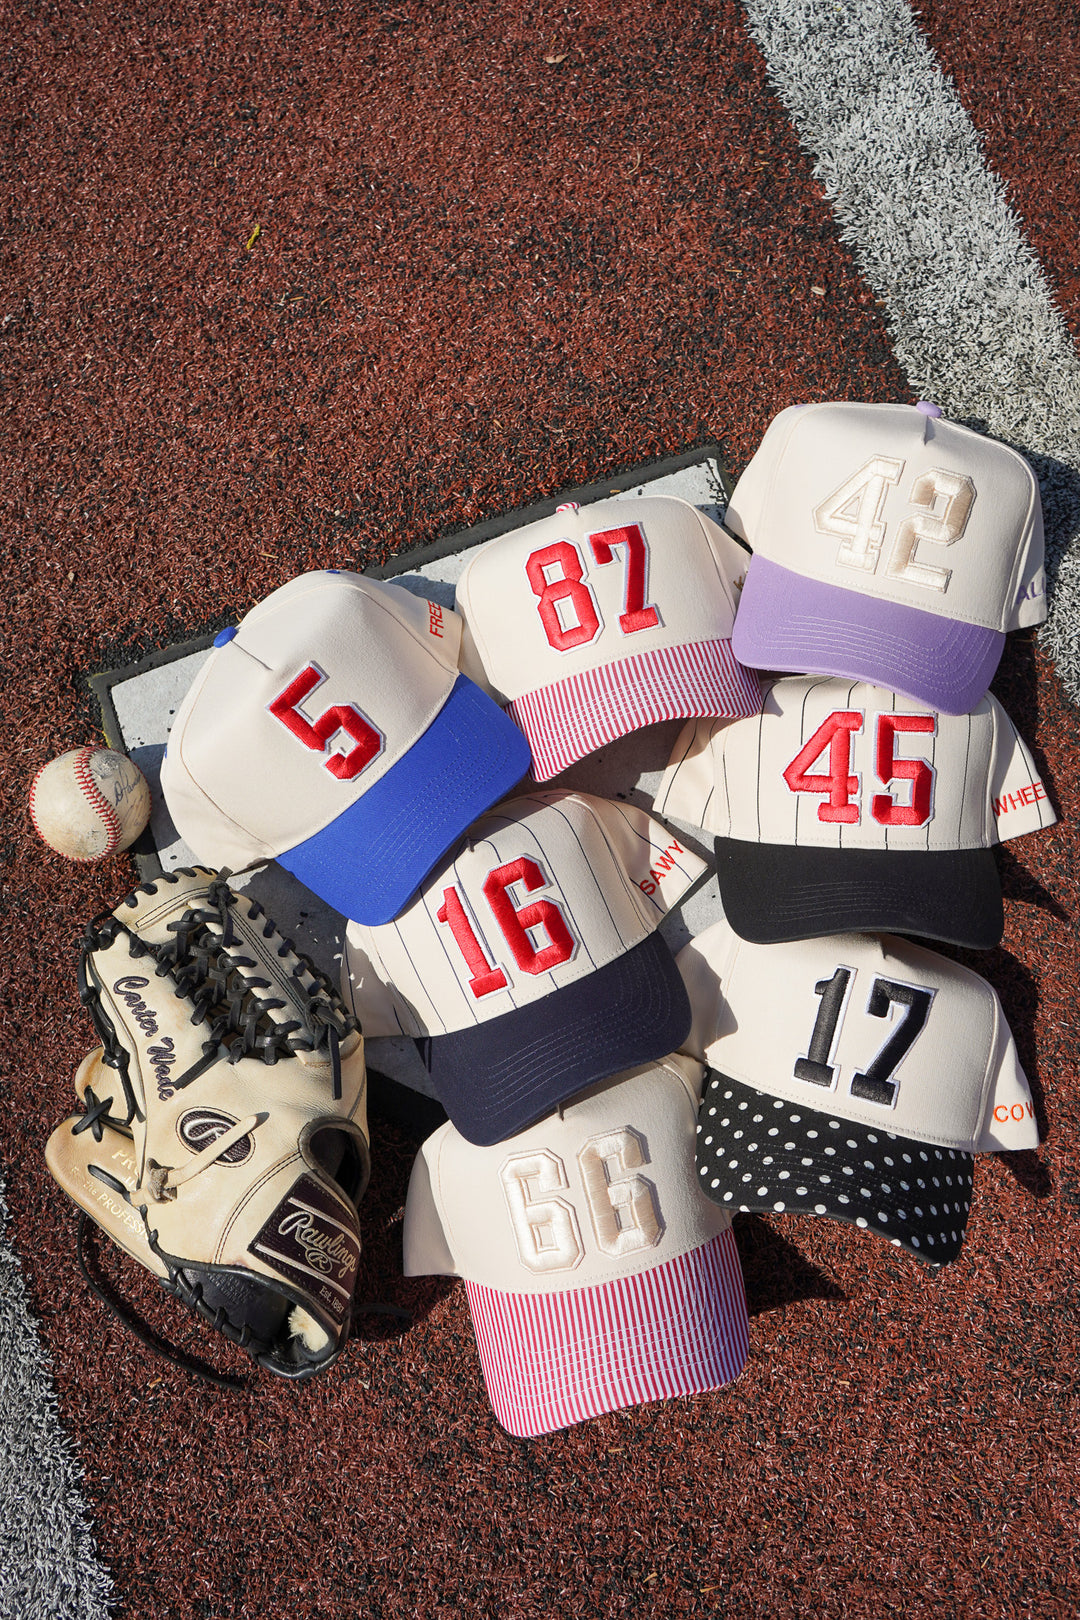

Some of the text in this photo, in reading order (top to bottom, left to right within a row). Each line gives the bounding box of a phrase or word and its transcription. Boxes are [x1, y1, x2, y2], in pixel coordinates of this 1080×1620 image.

[812, 454, 977, 594] 42
[427, 600, 444, 638] FREE
[523, 521, 664, 655] 87
[264, 660, 385, 783] 5
[781, 708, 939, 829] 45
[991, 780, 1048, 816] WHEE
[436, 853, 580, 1002] 16
[639, 837, 684, 895] SAWY
[113, 976, 177, 1101] Carter Wade
[793, 964, 940, 1111] 17
[96, 1191, 149, 1241] PROFESSI
[277, 1210, 357, 1279] Rawlings
[498, 1125, 666, 1275] 66
